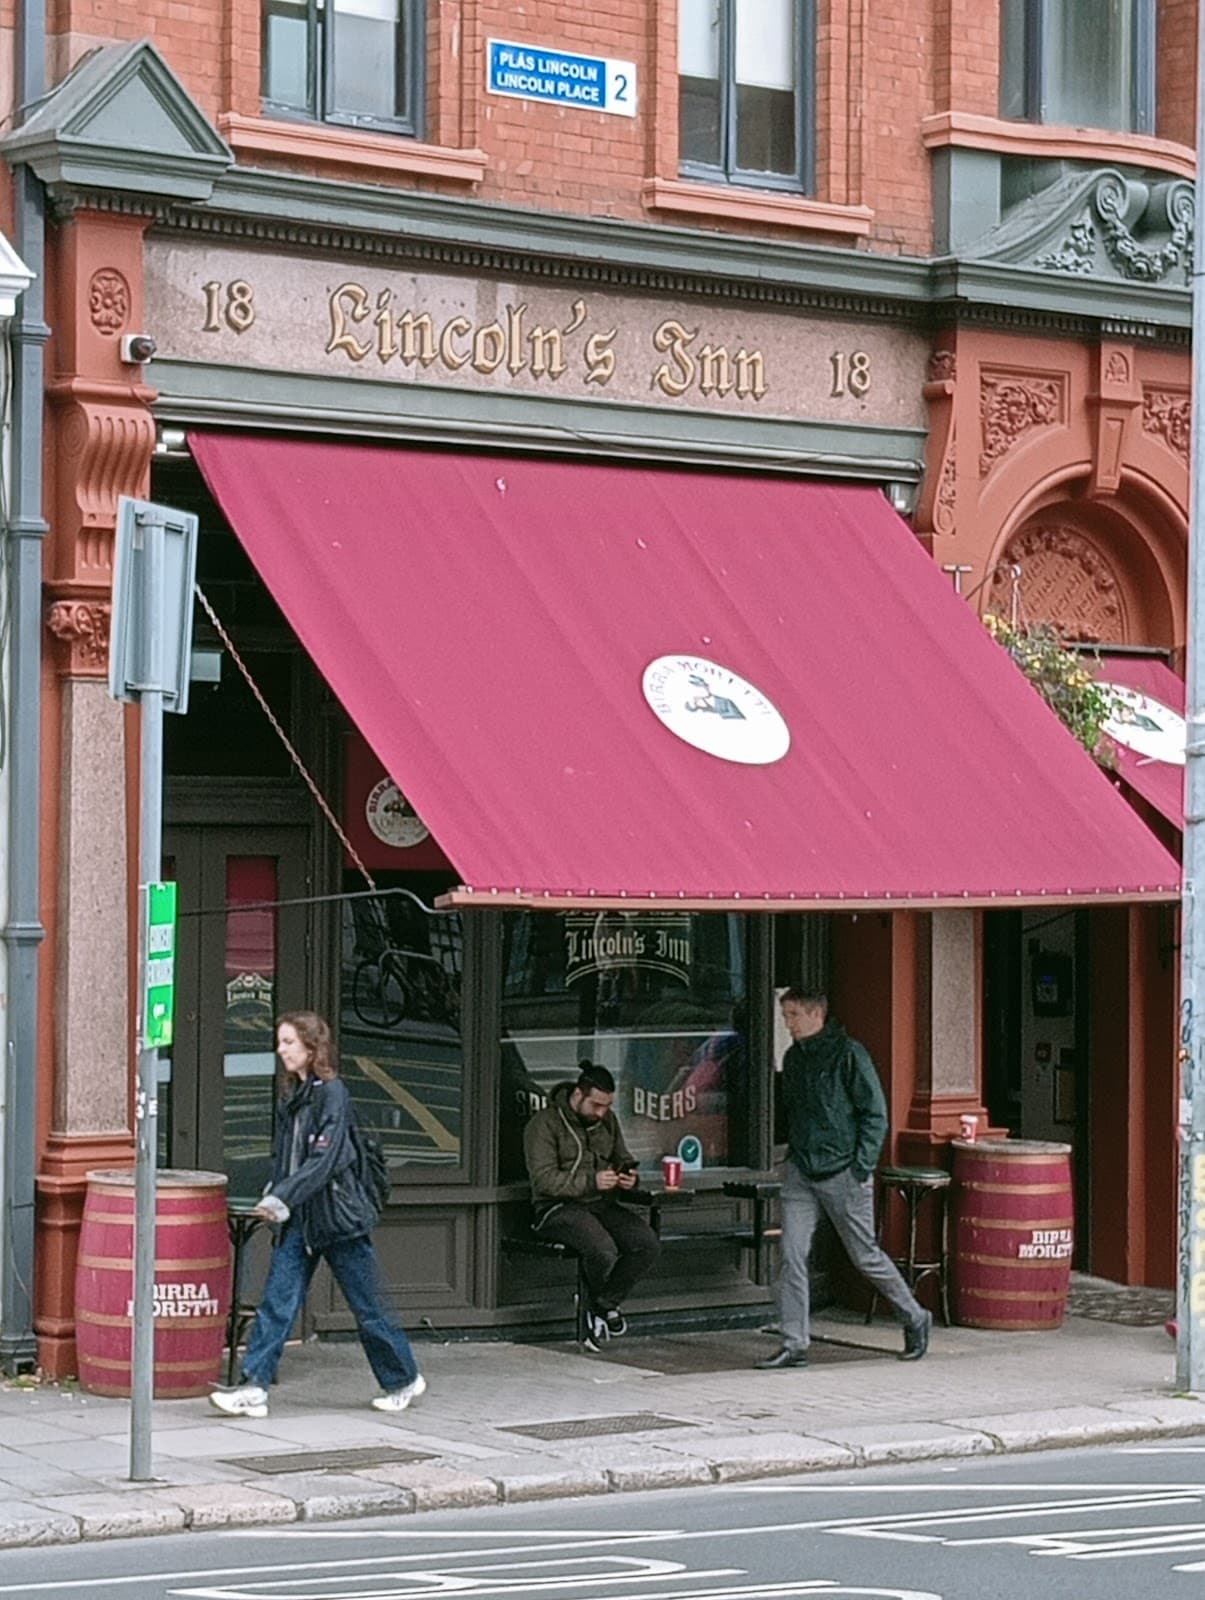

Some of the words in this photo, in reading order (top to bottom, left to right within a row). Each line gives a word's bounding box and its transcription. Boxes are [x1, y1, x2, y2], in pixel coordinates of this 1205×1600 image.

[499, 50, 535, 71] PLÁS
[537, 58, 599, 82] LINCOLN
[496, 71, 556, 95] LINCOLN
[557, 81, 600, 102] PLACE
[614, 73, 628, 102] 2
[201, 279, 256, 335] 18
[325, 282, 618, 386] Lincoln's
[652, 319, 769, 402] Inn
[829, 351, 872, 399] 18
[564, 929, 647, 970] Lincoln's
[655, 929, 691, 966] Inn
[633, 1085, 697, 1121] BEERS
